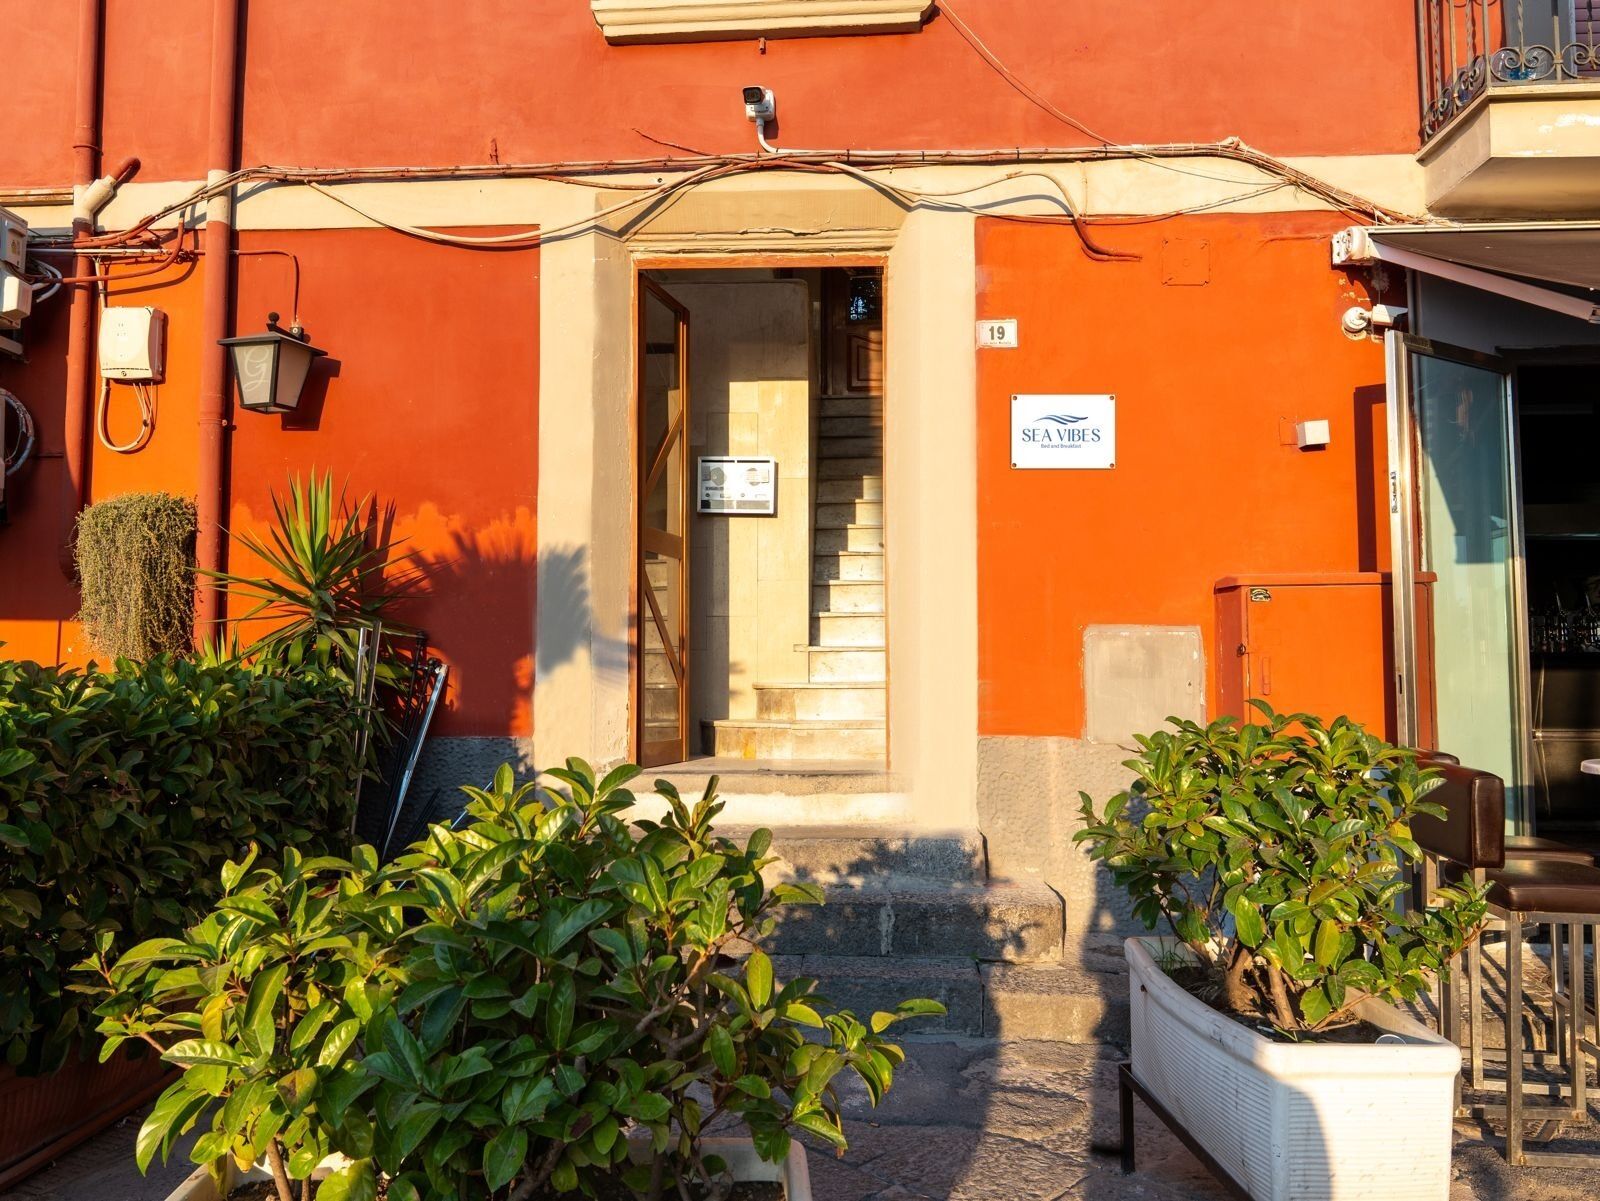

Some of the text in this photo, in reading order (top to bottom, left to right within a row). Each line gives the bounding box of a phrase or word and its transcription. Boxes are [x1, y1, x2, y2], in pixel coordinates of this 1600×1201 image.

[989, 326, 1005, 340] 19
[1022, 428, 1101, 442] SEA VIBES
